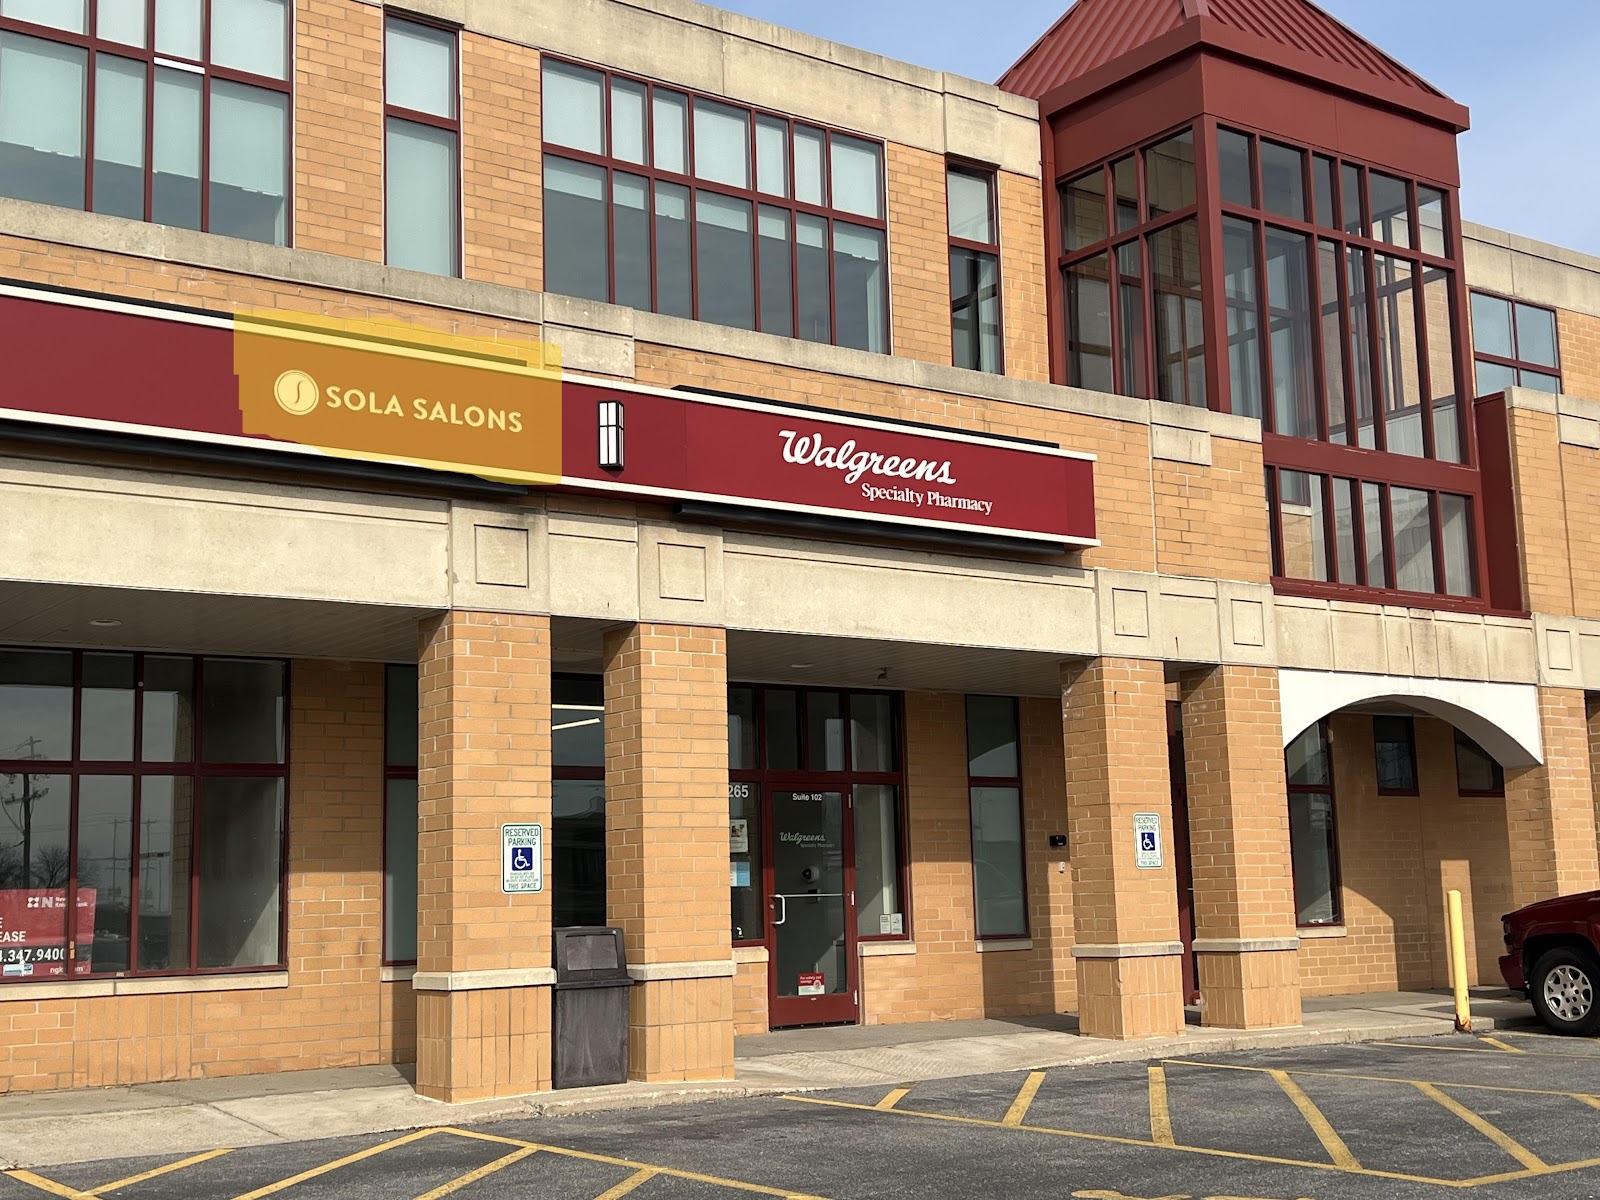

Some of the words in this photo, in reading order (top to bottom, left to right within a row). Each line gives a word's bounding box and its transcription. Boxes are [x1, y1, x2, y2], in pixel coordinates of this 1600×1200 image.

[326, 385, 404, 417] SOLA
[413, 397, 523, 433] SALONS
[778, 429, 957, 485] Walgreens
[861, 482, 925, 507] Specialty
[926, 490, 993, 516] Pharmacy
[505, 828, 539, 837] RESERVED
[508, 838, 536, 846] PARKING
[780, 832, 826, 844] Walgreens
